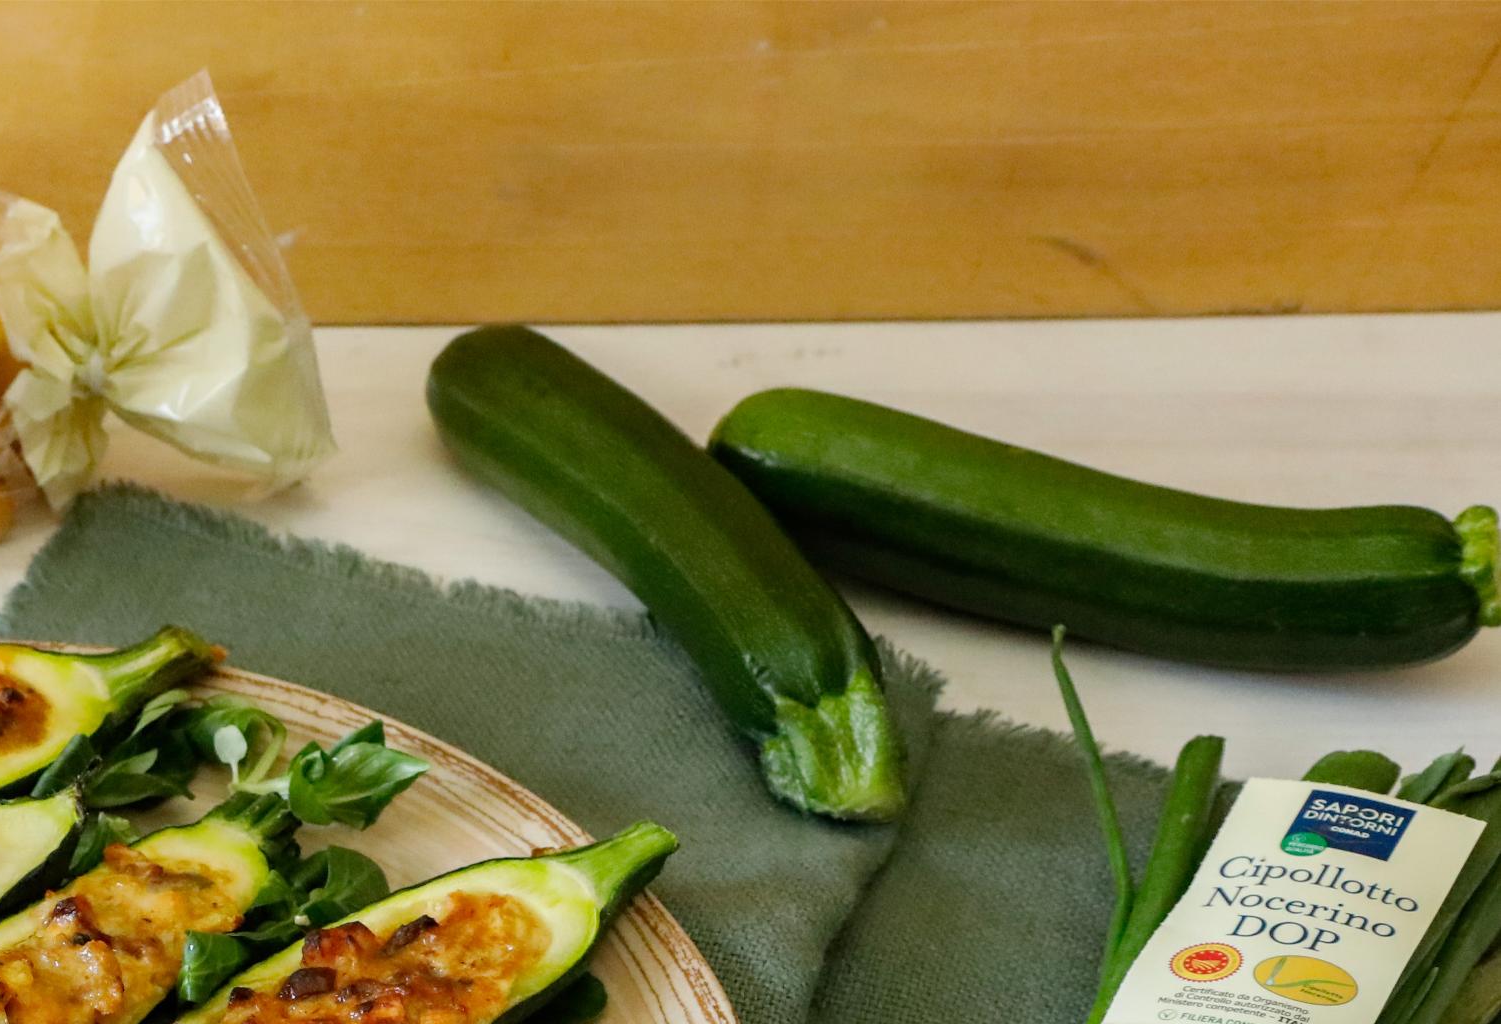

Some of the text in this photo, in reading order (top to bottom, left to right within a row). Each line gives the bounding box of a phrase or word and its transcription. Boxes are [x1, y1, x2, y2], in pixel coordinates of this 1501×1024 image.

[1303, 810, 1398, 836] DINTORNI
[1309, 799, 1405, 828] SAPORI
[1330, 825, 1370, 839] CONAD
[1219, 855, 1420, 913] Cipollotto
[1202, 886, 1396, 938] Nocerino
[1226, 914, 1341, 952] DOP
[1157, 996, 1204, 1008] Ministero
[1205, 1003, 1267, 1019] competente
[1174, 991, 1311, 1023] di Controllo autorizzato dal
[1182, 985, 1235, 999] Certificato
[1237, 992, 1250, 1001] da
[1252, 995, 1310, 1015] Organismo
